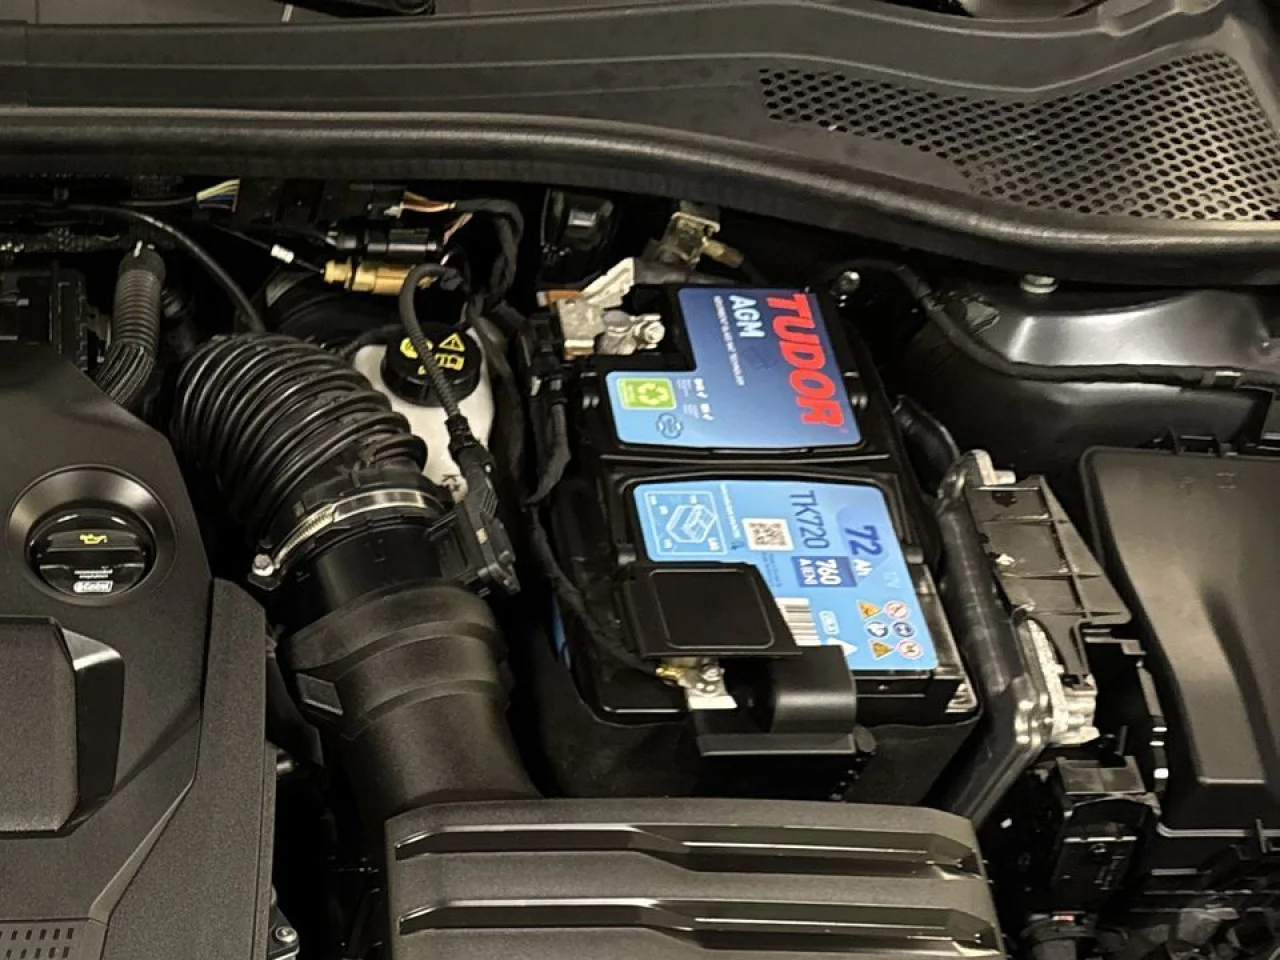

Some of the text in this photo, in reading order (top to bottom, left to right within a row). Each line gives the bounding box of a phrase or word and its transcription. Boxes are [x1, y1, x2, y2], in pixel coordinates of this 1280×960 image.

[728, 294, 766, 338] AGM
[766, 292, 845, 427] TUDOR
[789, 489, 830, 549] TK720
[844, 524, 884, 556] 72
[815, 558, 841, 585] 760
